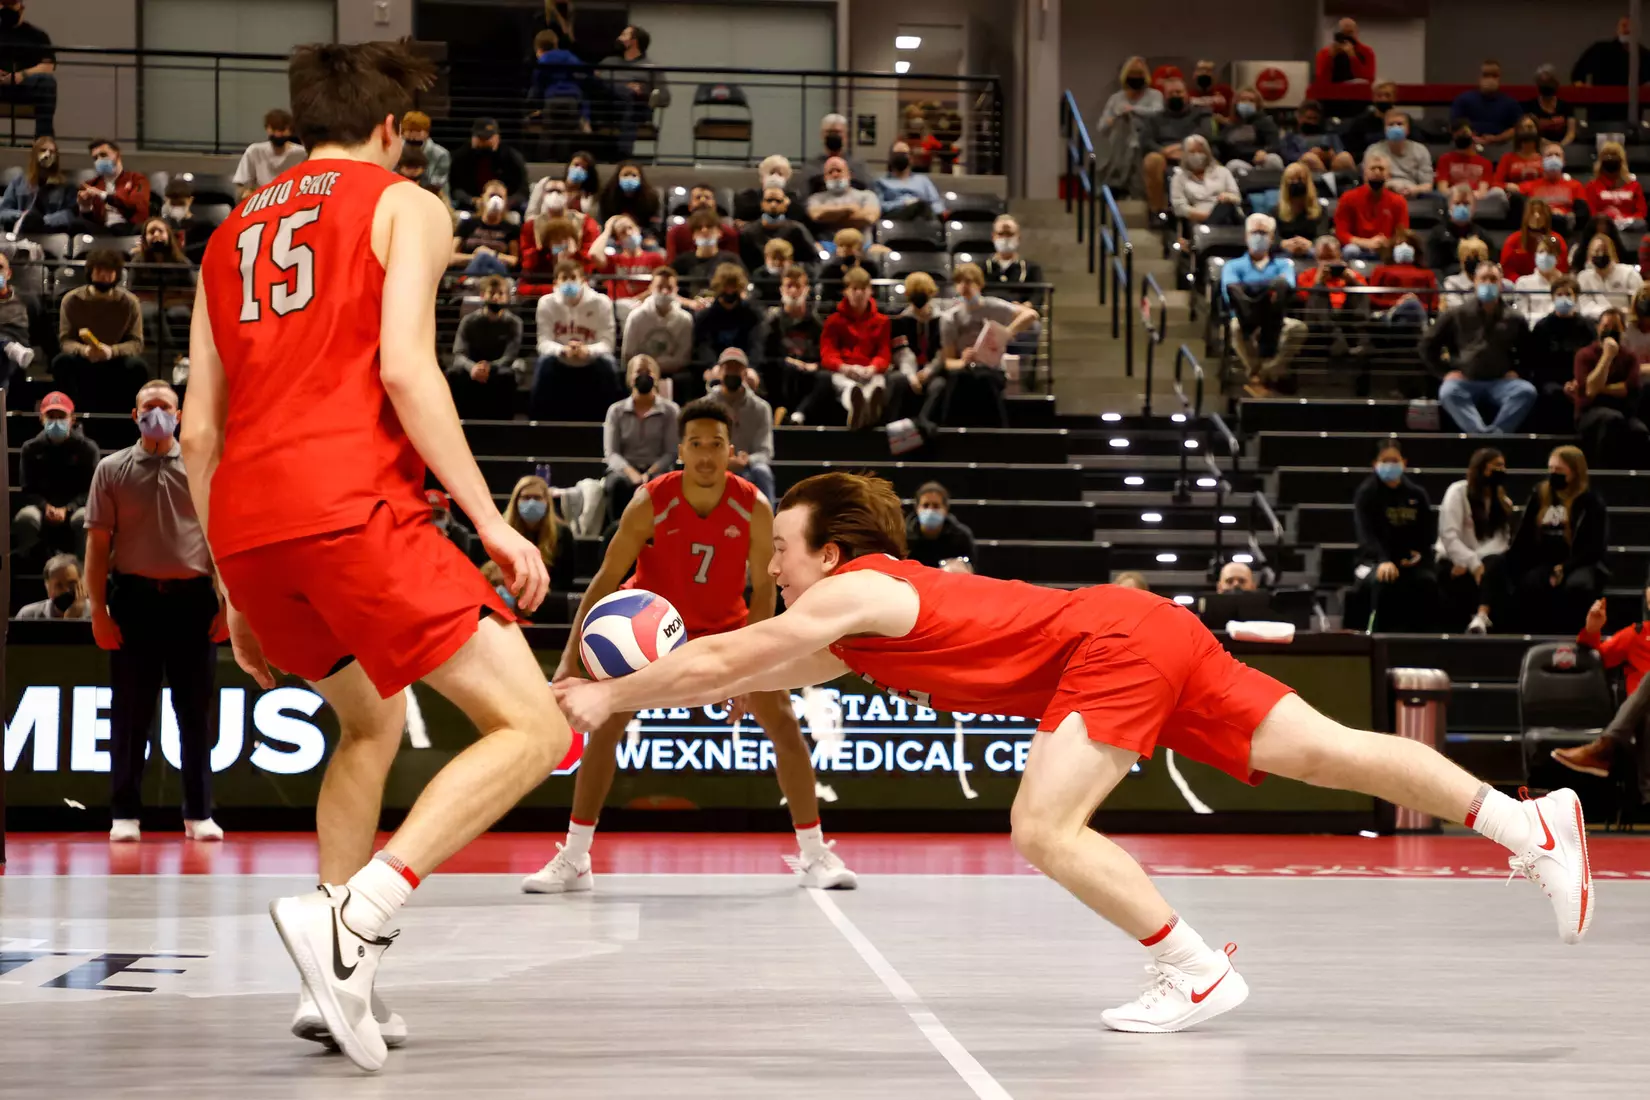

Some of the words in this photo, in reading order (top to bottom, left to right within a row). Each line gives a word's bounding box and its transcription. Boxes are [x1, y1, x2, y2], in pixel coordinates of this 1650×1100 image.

[241, 179, 294, 218] OHIO
[235, 202, 322, 322] 15
[691, 541, 715, 584] 7
[663, 617, 683, 638] NCAA
[615, 739, 777, 770] WEXNER
